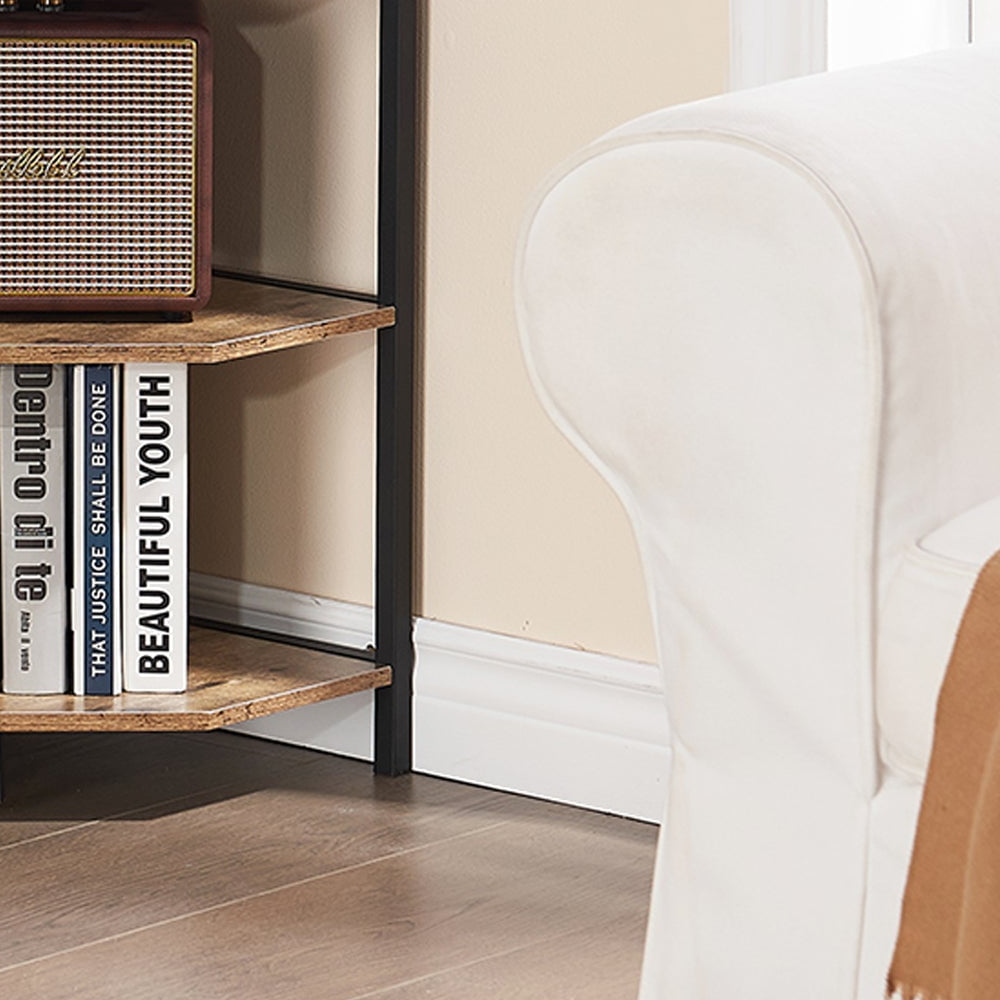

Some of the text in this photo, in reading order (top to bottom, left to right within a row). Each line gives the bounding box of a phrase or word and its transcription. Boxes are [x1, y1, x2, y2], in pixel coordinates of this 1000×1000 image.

[13, 364, 54, 601] Dentro di te
[91, 383, 107, 678] THAT JUSTICE SHALL BE DONE
[138, 375, 171, 674] BEAUTIFUL YOUTH
